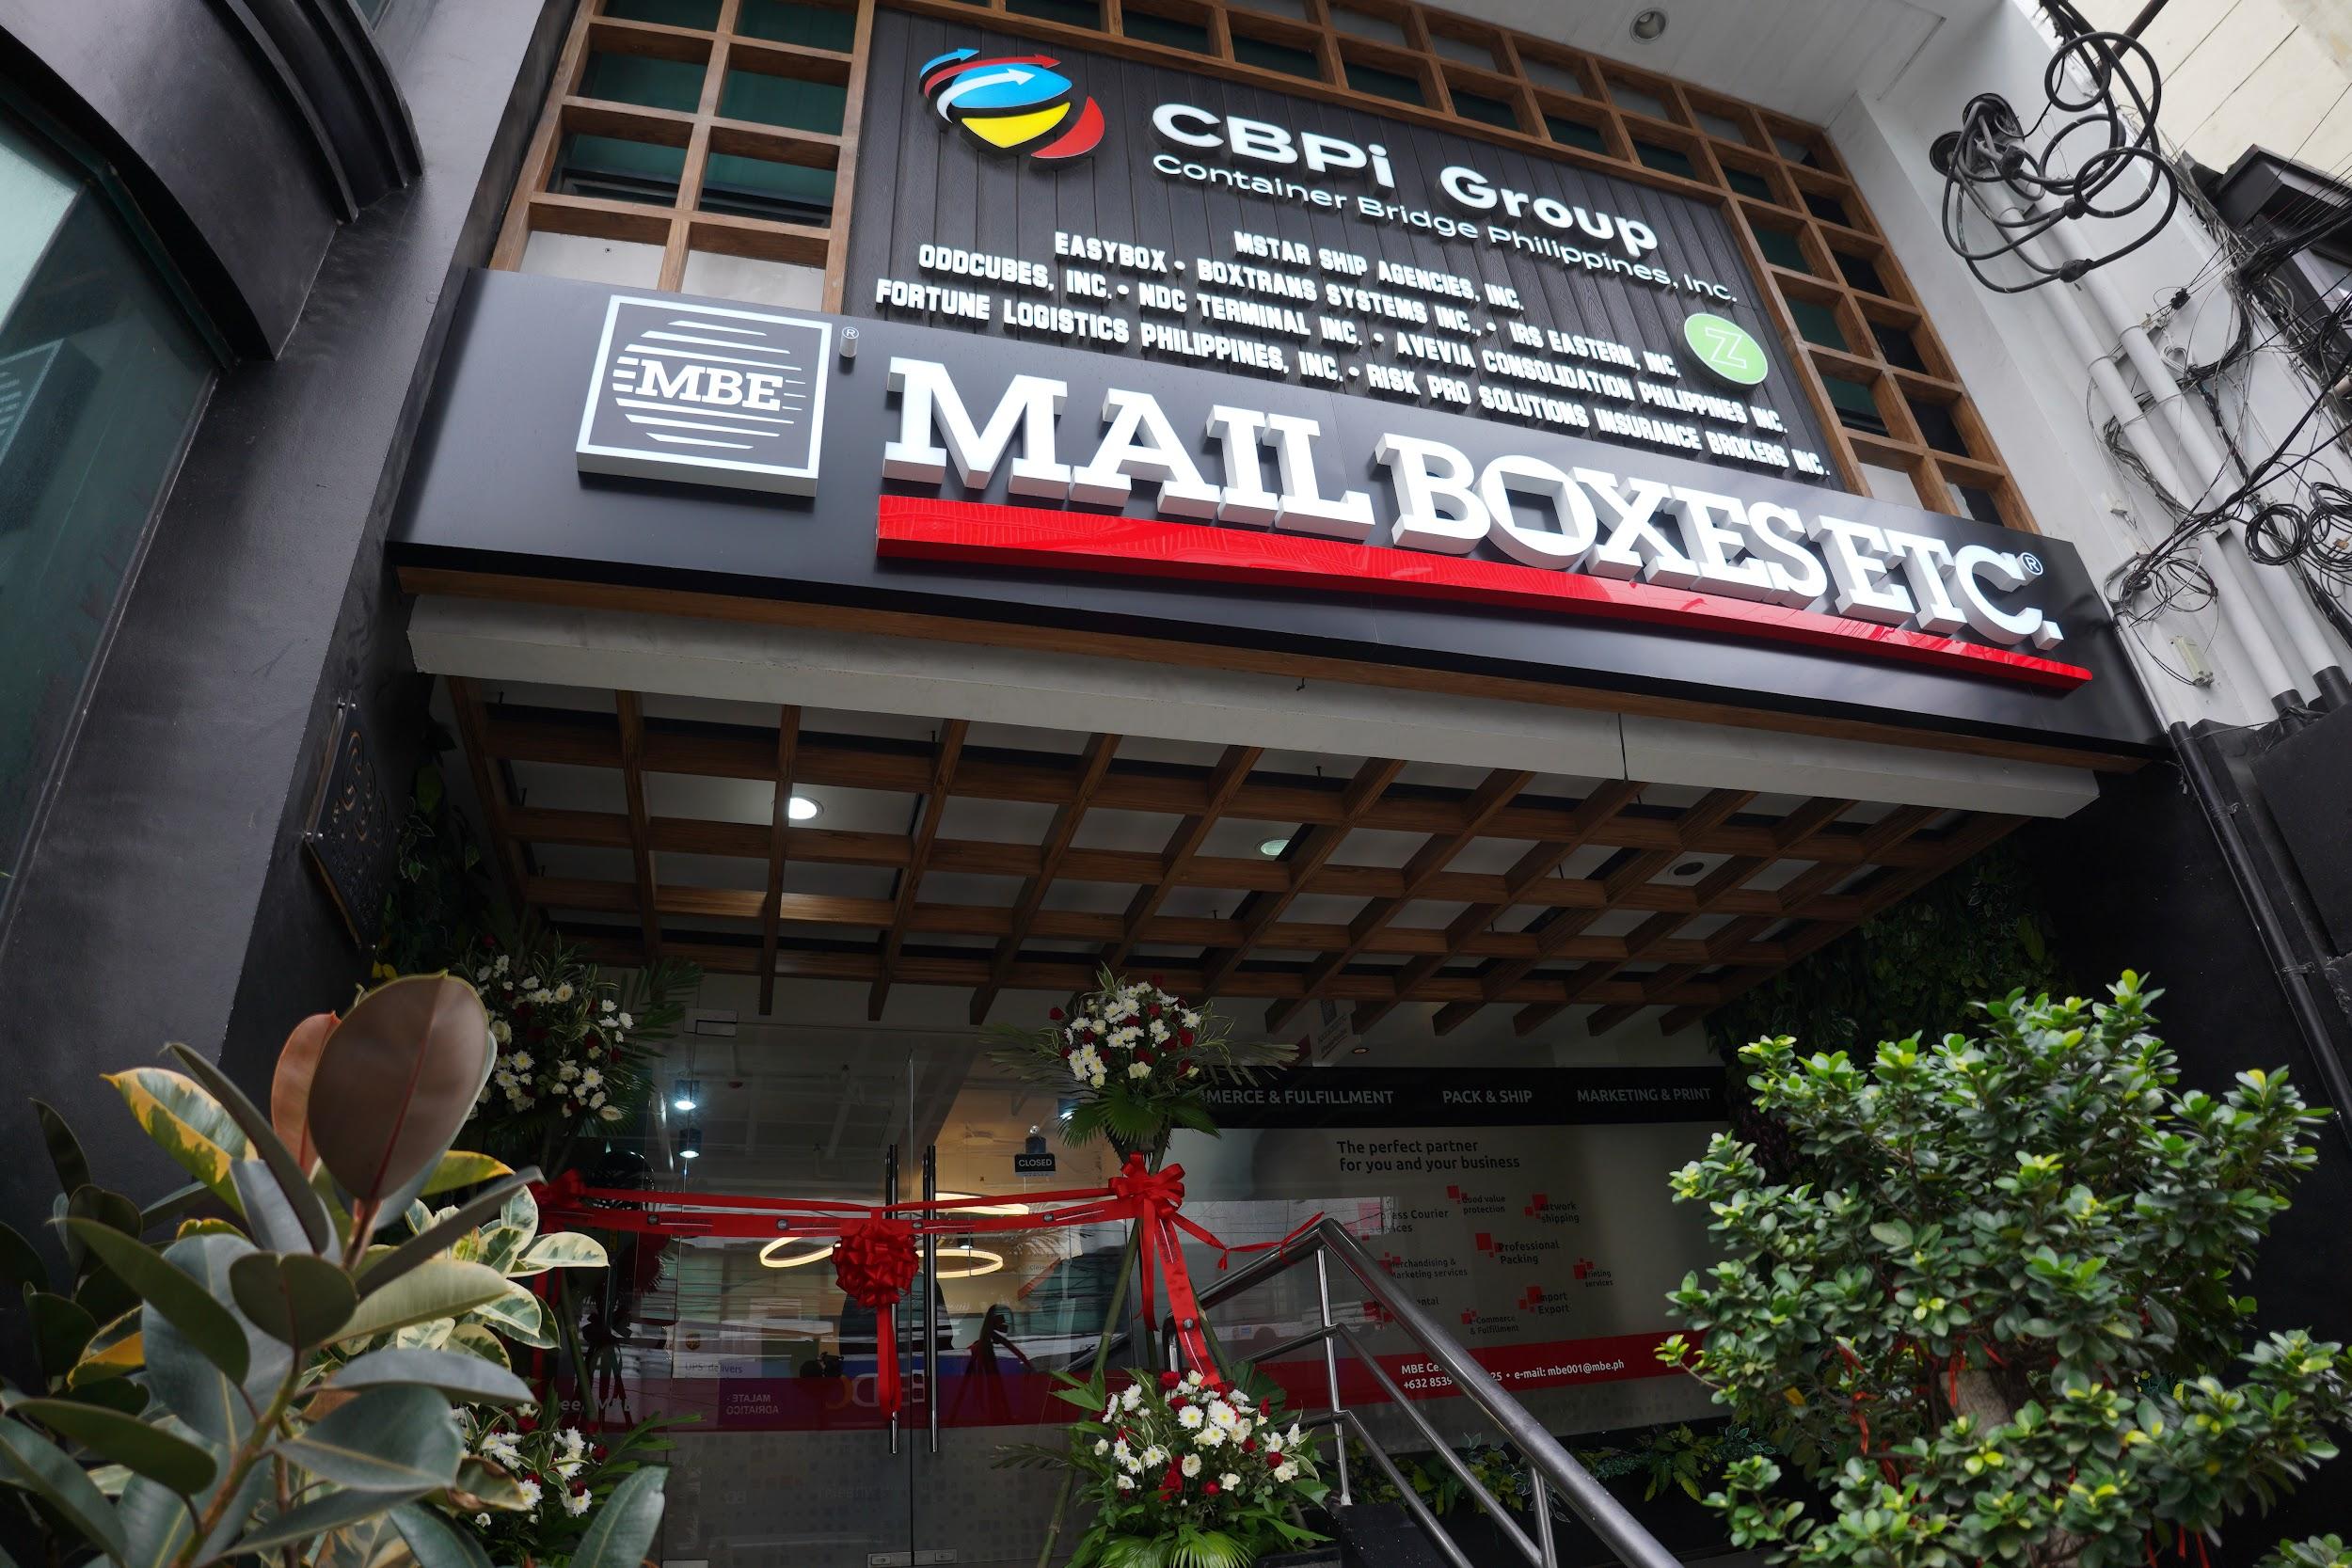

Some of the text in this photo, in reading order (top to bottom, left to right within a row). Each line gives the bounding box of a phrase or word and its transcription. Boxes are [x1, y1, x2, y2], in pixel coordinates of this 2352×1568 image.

[1152, 103, 1658, 259] CBPi Group
[1152, 154, 1738, 302] Container Bridge Philippines, Inc.
[1234, 231, 1525, 311] MSTAR SHIP AGENCIES, INC.
[1054, 232, 1168, 274] EASYBOX
[1198, 258, 1317, 302] BOXTRANS
[1326, 283, 1428, 325] SYSTEMS
[1509, 321, 1544, 349] IRS
[1548, 329, 1641, 371] EASTERN,
[1643, 351, 1681, 378] INC.
[918, 244, 1788, 434] ODDCUBES, INC. NDC TERMINAL INC. AVEVIA CONSOLIDATION PHILIPPINES INC.
[635, 358, 784, 412] MBE
[876, 278, 1831, 477] FORTUNE LOGISTICS PHILIPPINES, INC. RISK PRO SOLUTIONS INSURANCE BROKERS INC.
[882, 356, 1375, 540] MAIL
[1376, 432, 1828, 606] BOXES
[1811, 515, 2064, 651] ETC.
[1268, 1089, 1282, 1104] &
[1284, 1089, 1394, 1105] FULFILLMENT
[1442, 1088, 1534, 1104] PACK & SHIP
[1577, 1086, 1712, 1103] MARKETING & PRINT
[1337, 1139, 1479, 1156] The perfect partner
[1018, 1158, 1053, 1167] CLOSED
[1340, 1155, 1520, 1174] for you and your business
[1410, 1209, 1449, 1220] Courier
[1541, 1212, 1580, 1224] shipping
[1498, 1239, 1560, 1252] Professional
[1500, 1254, 1539, 1264] Packing
[1537, 1304, 1571, 1315] Export
[1401, 1363, 1424, 1375] MBE
[1403, 1377, 1428, 1389] +632
[1514, 1367, 1547, 1380] e-mail:
[1548, 1358, 1625, 1377] mbe001@mbe.ph
